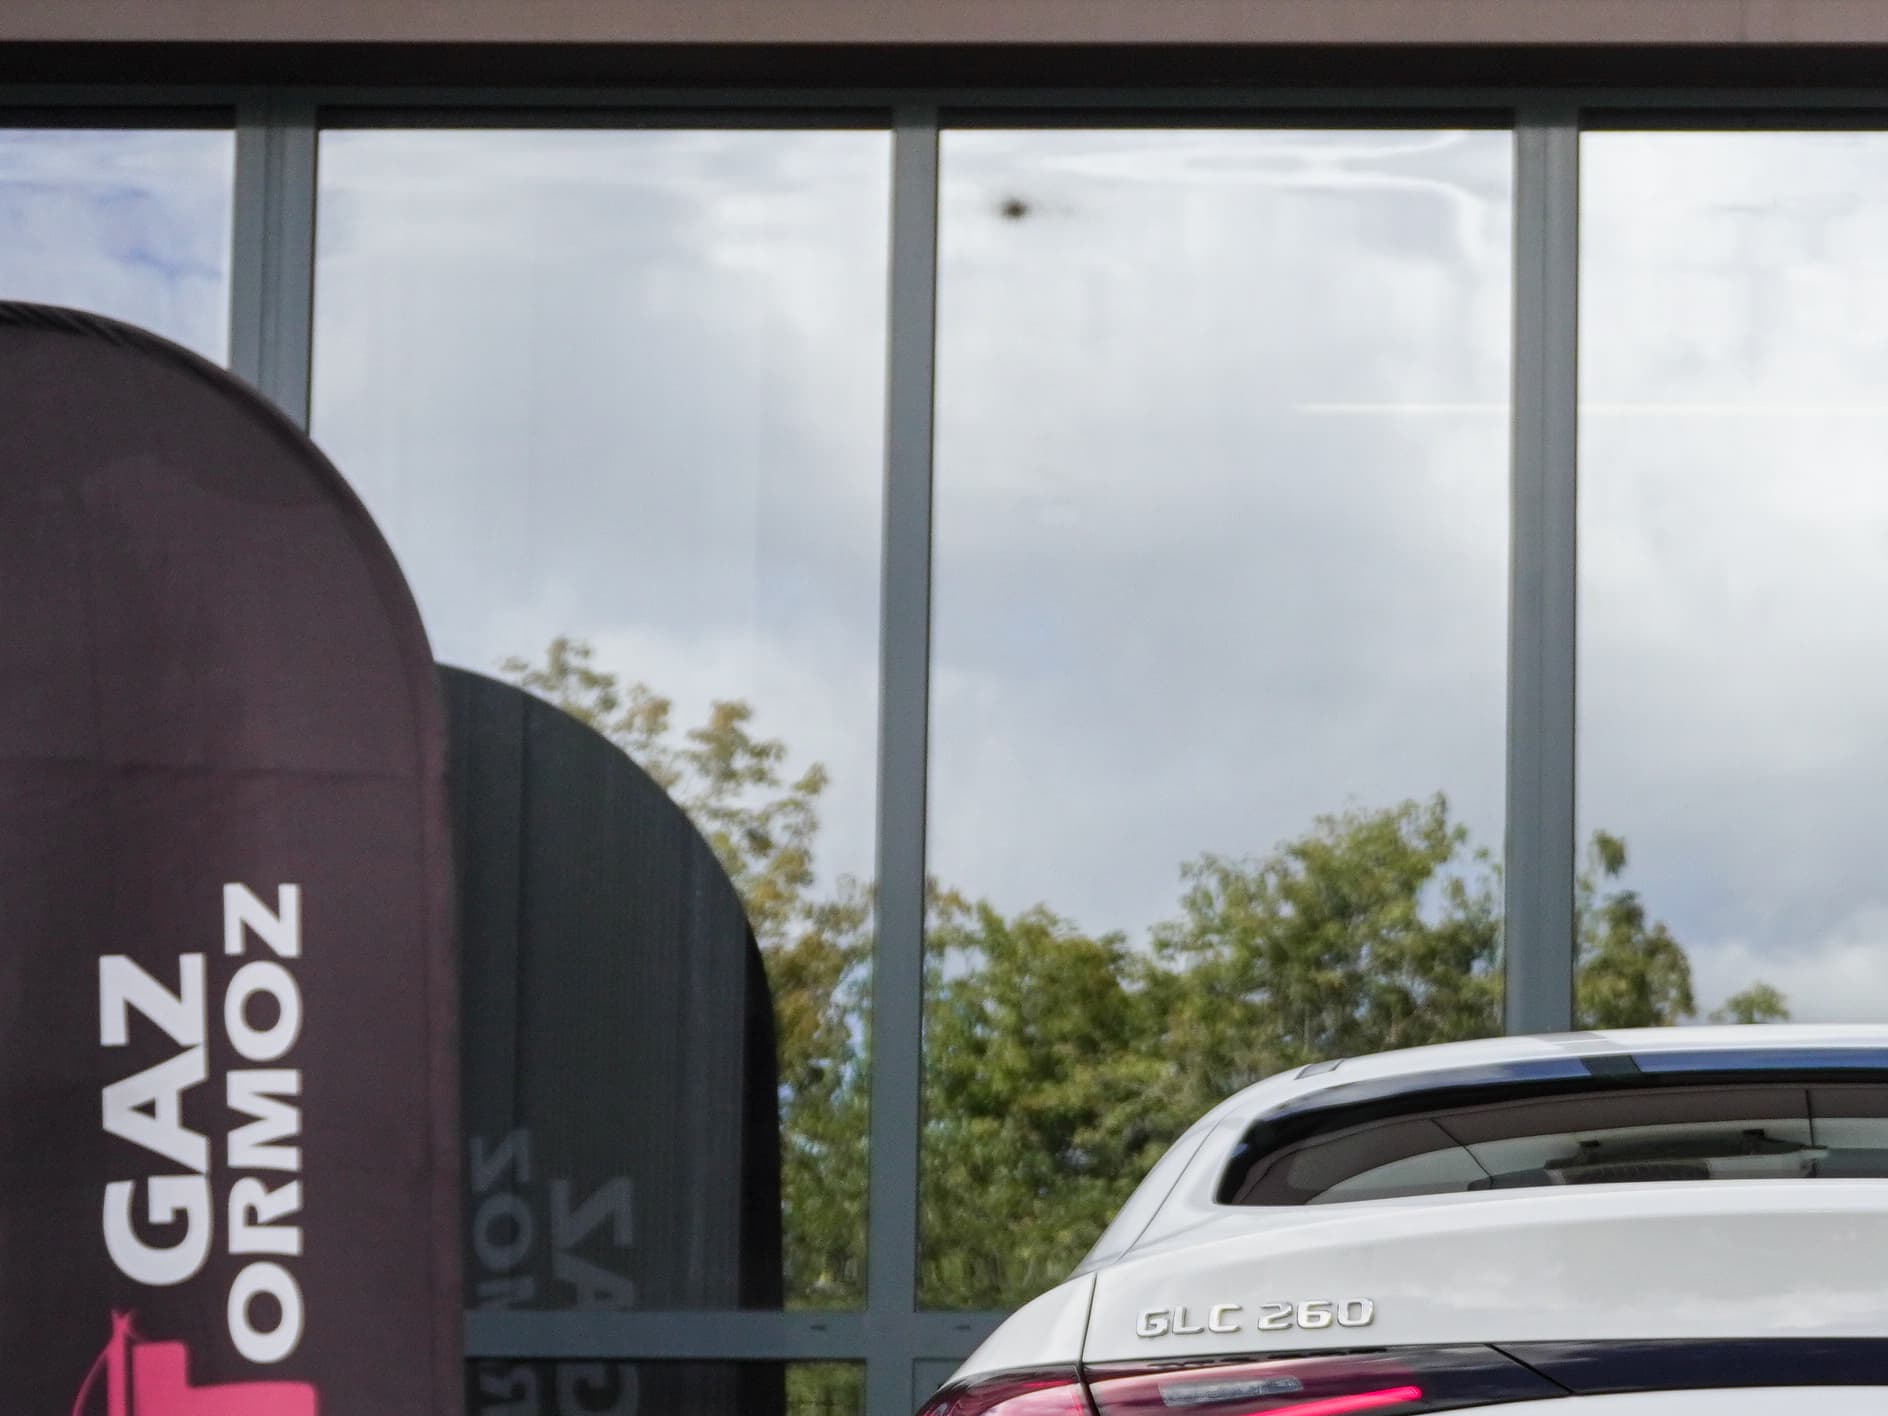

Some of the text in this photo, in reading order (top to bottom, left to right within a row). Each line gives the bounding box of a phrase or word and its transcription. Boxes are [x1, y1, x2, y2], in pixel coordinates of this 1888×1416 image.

[100, 953, 212, 1285] GAZ
[223, 883, 304, 1363] ORMOZ
[1136, 1298, 1375, 1337] GLC 260
